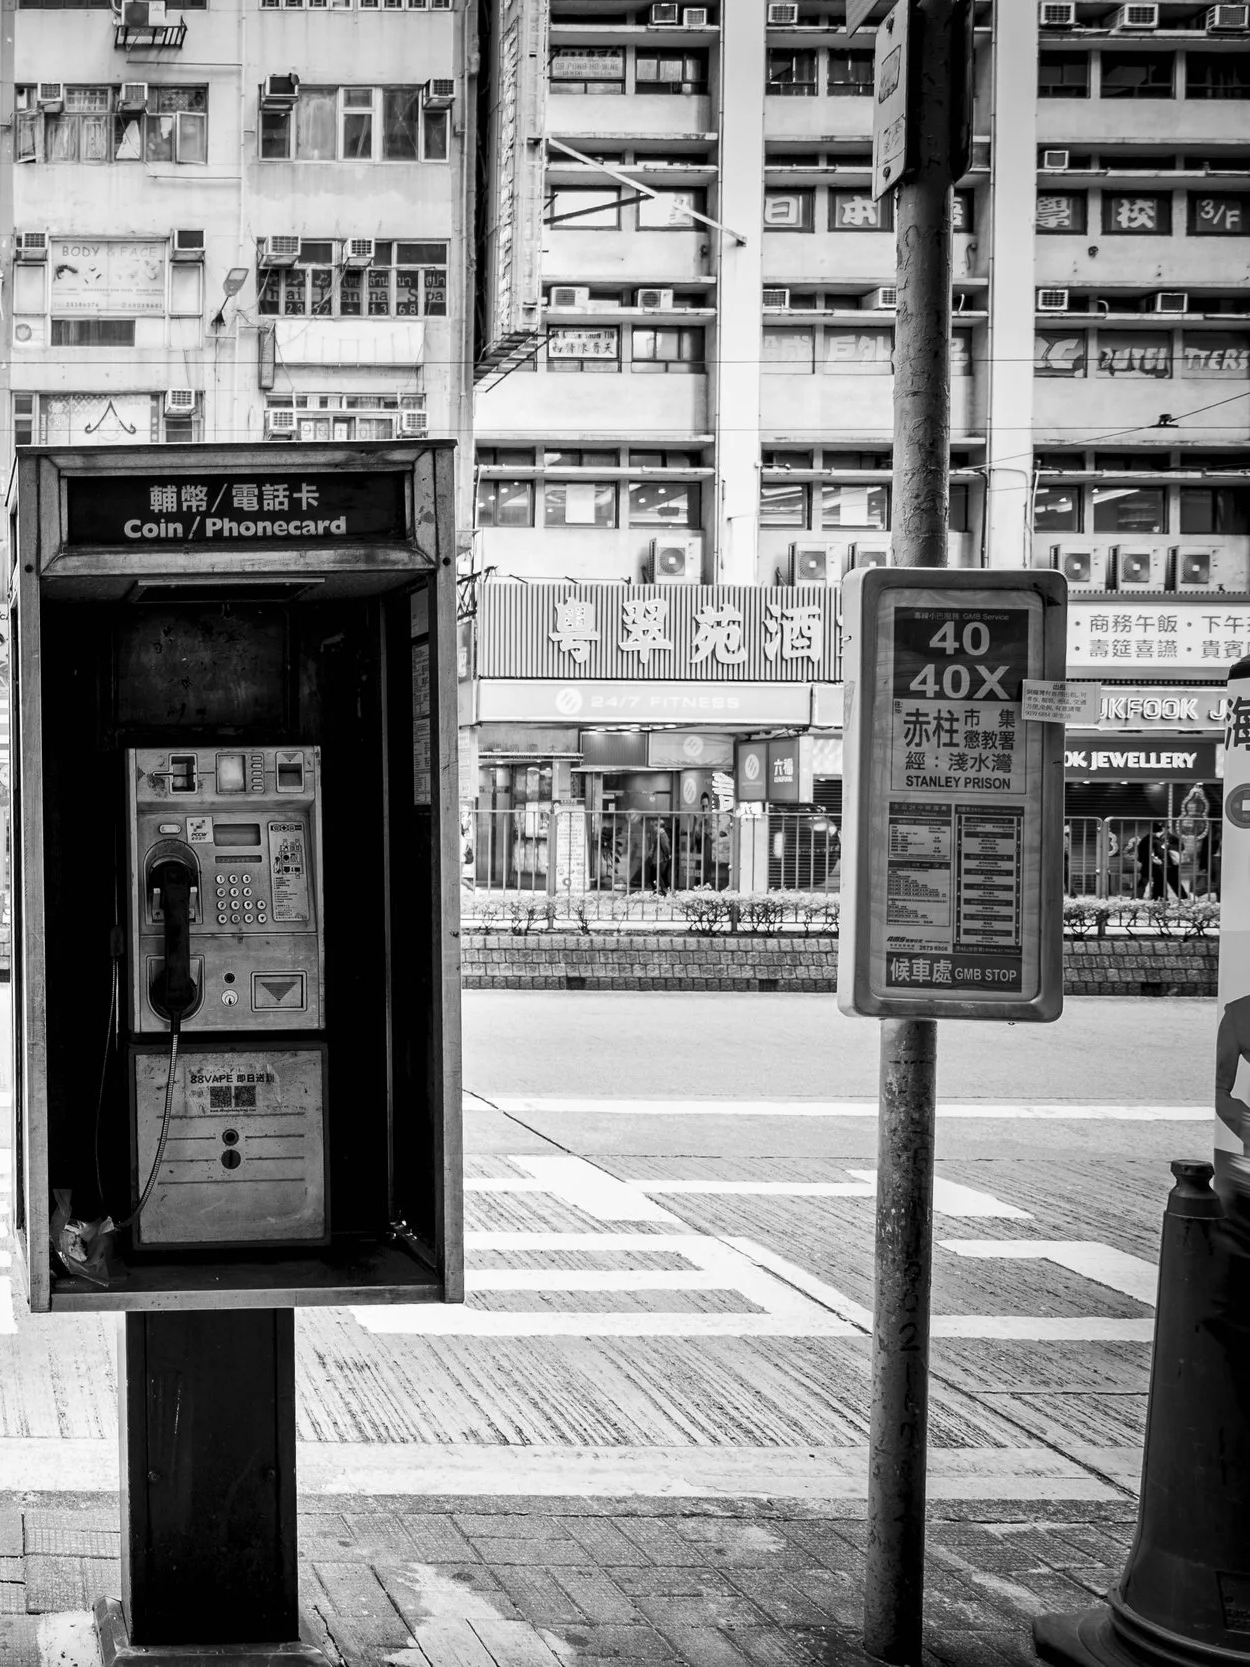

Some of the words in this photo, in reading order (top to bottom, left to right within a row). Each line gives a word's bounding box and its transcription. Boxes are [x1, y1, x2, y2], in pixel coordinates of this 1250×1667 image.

[1200, 200, 1240, 230] 3/F
[62, 246, 100, 257] BODY
[120, 247, 158, 257] FACE
[407, 288, 443, 302] Spa
[123, 518, 184, 538] Coin
[205, 516, 347, 537] Phonecard
[983, 613, 1010, 621] Service
[1090, 614, 1178, 633] 商務午飯
[1201, 615, 1250, 633] 下午
[549, 597, 843, 665] 粵翠苑酒
[928, 621, 990, 656] 40
[1201, 640, 1250, 659] 貴賓
[909, 663, 1011, 700] 40X
[591, 696, 640, 709] 24/7
[650, 696, 740, 709] FITNESS
[903, 708, 960, 749] 赤柱
[963, 730, 1016, 750] 懲教署
[774, 758, 794, 776] 六福
[1089, 751, 1198, 770] JEWELLERY
[906, 775, 961, 788] STANLEY
[964, 776, 1011, 790] PRISON
[890, 957, 952, 983] 候車處
[954, 967, 982, 981] GMB
[985, 968, 1017, 982] STOP
[190, 1074, 233, 1084] 88VAPE
